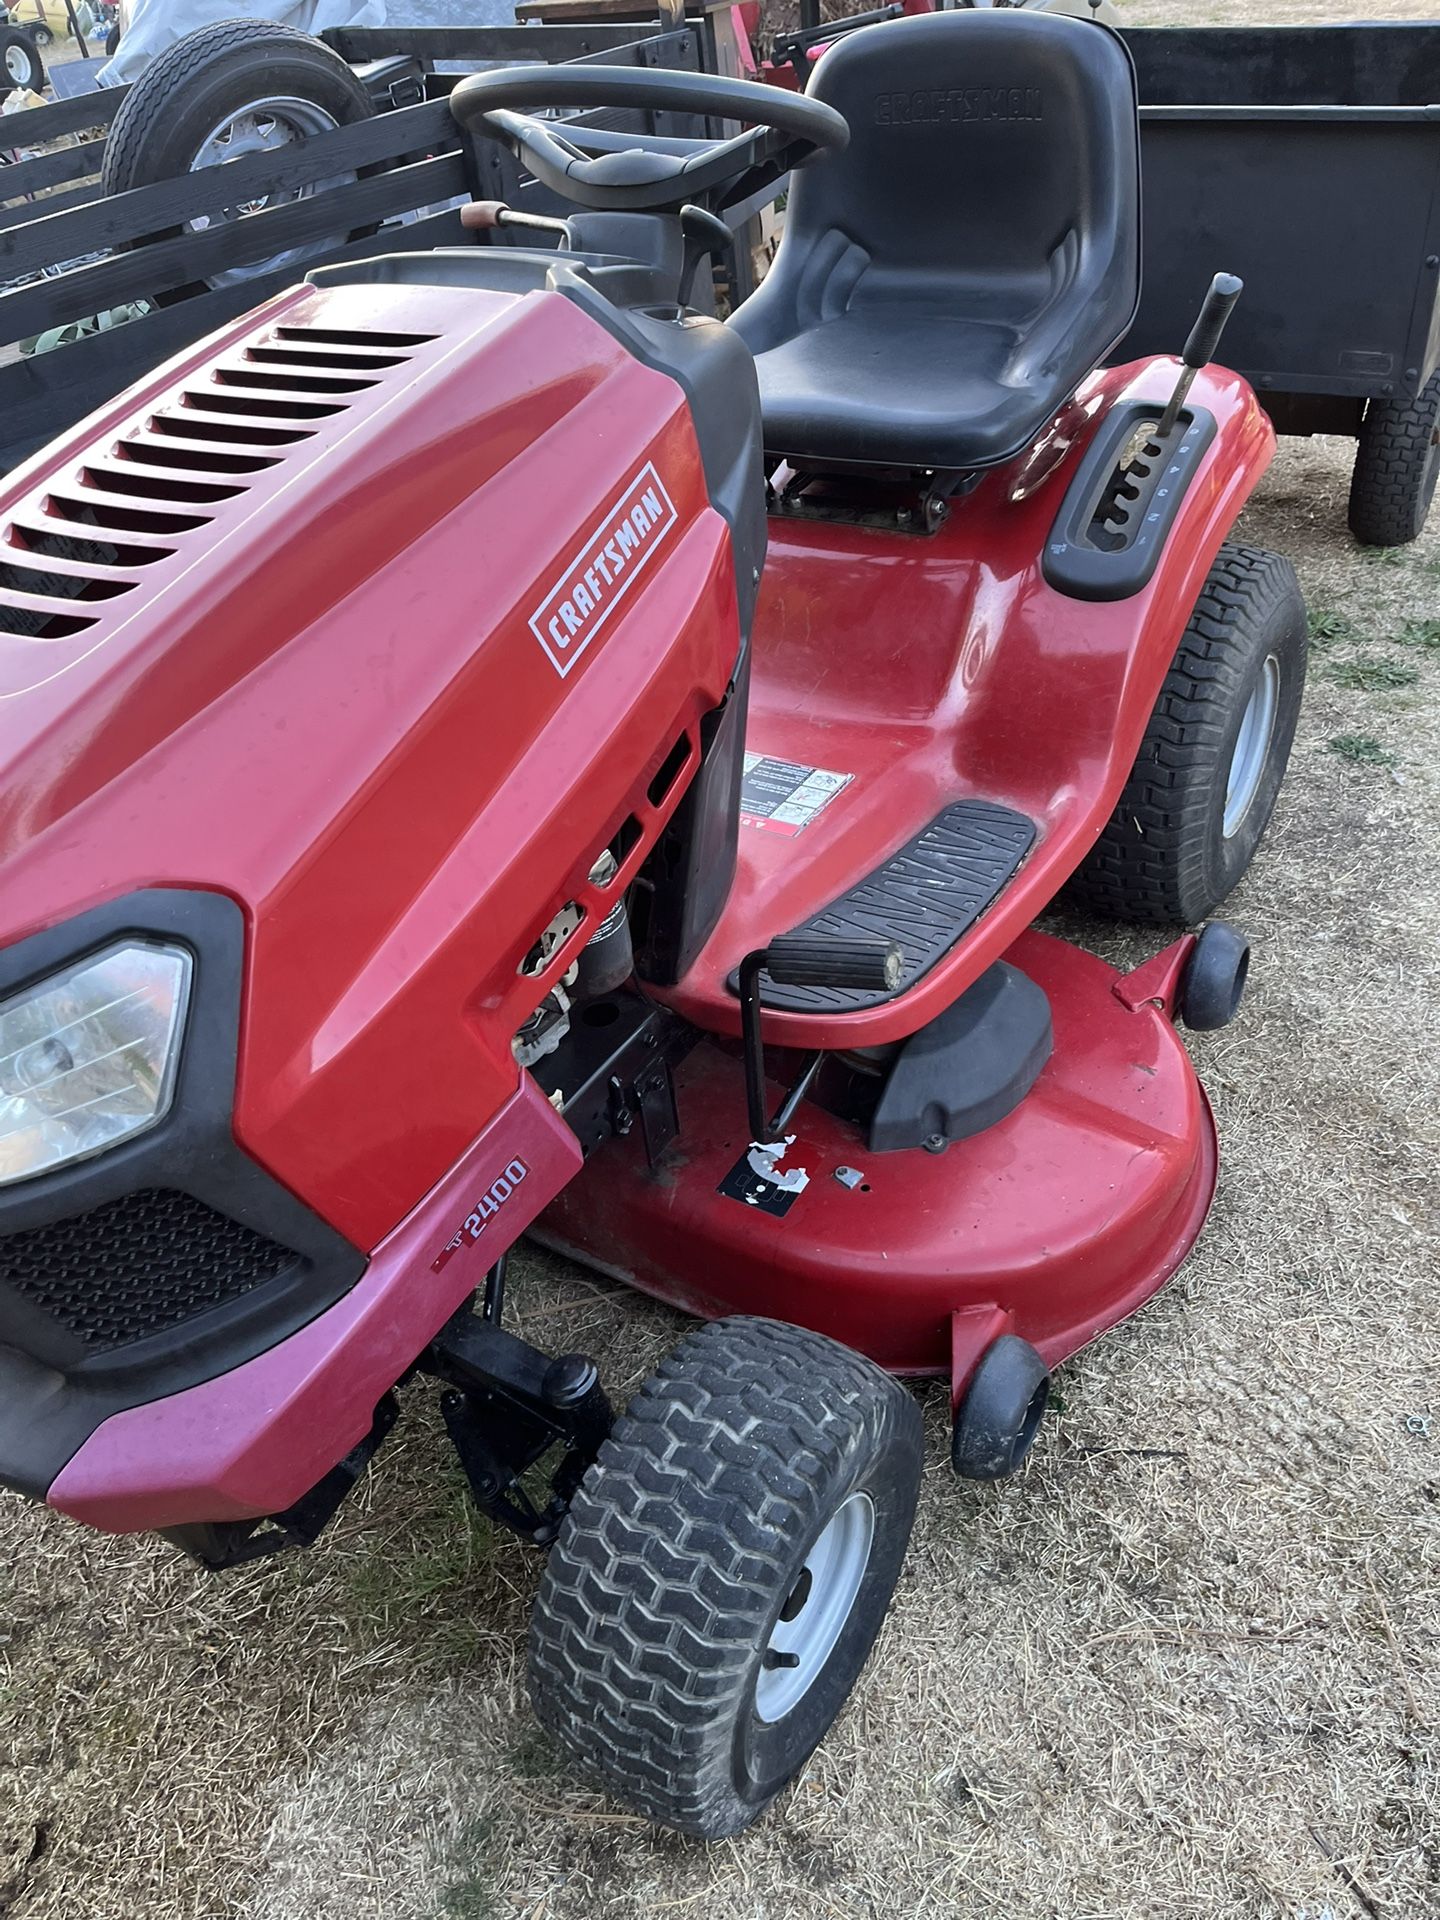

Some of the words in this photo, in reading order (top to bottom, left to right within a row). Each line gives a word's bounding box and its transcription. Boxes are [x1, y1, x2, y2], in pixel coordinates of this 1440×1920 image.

[875, 87, 1043, 125] CRAFTSMAN
[1169, 466, 1180, 474] 4
[1157, 489, 1168, 497] 3
[1147, 512, 1160, 522] 2
[548, 486, 664, 648] CRAFTSMAN
